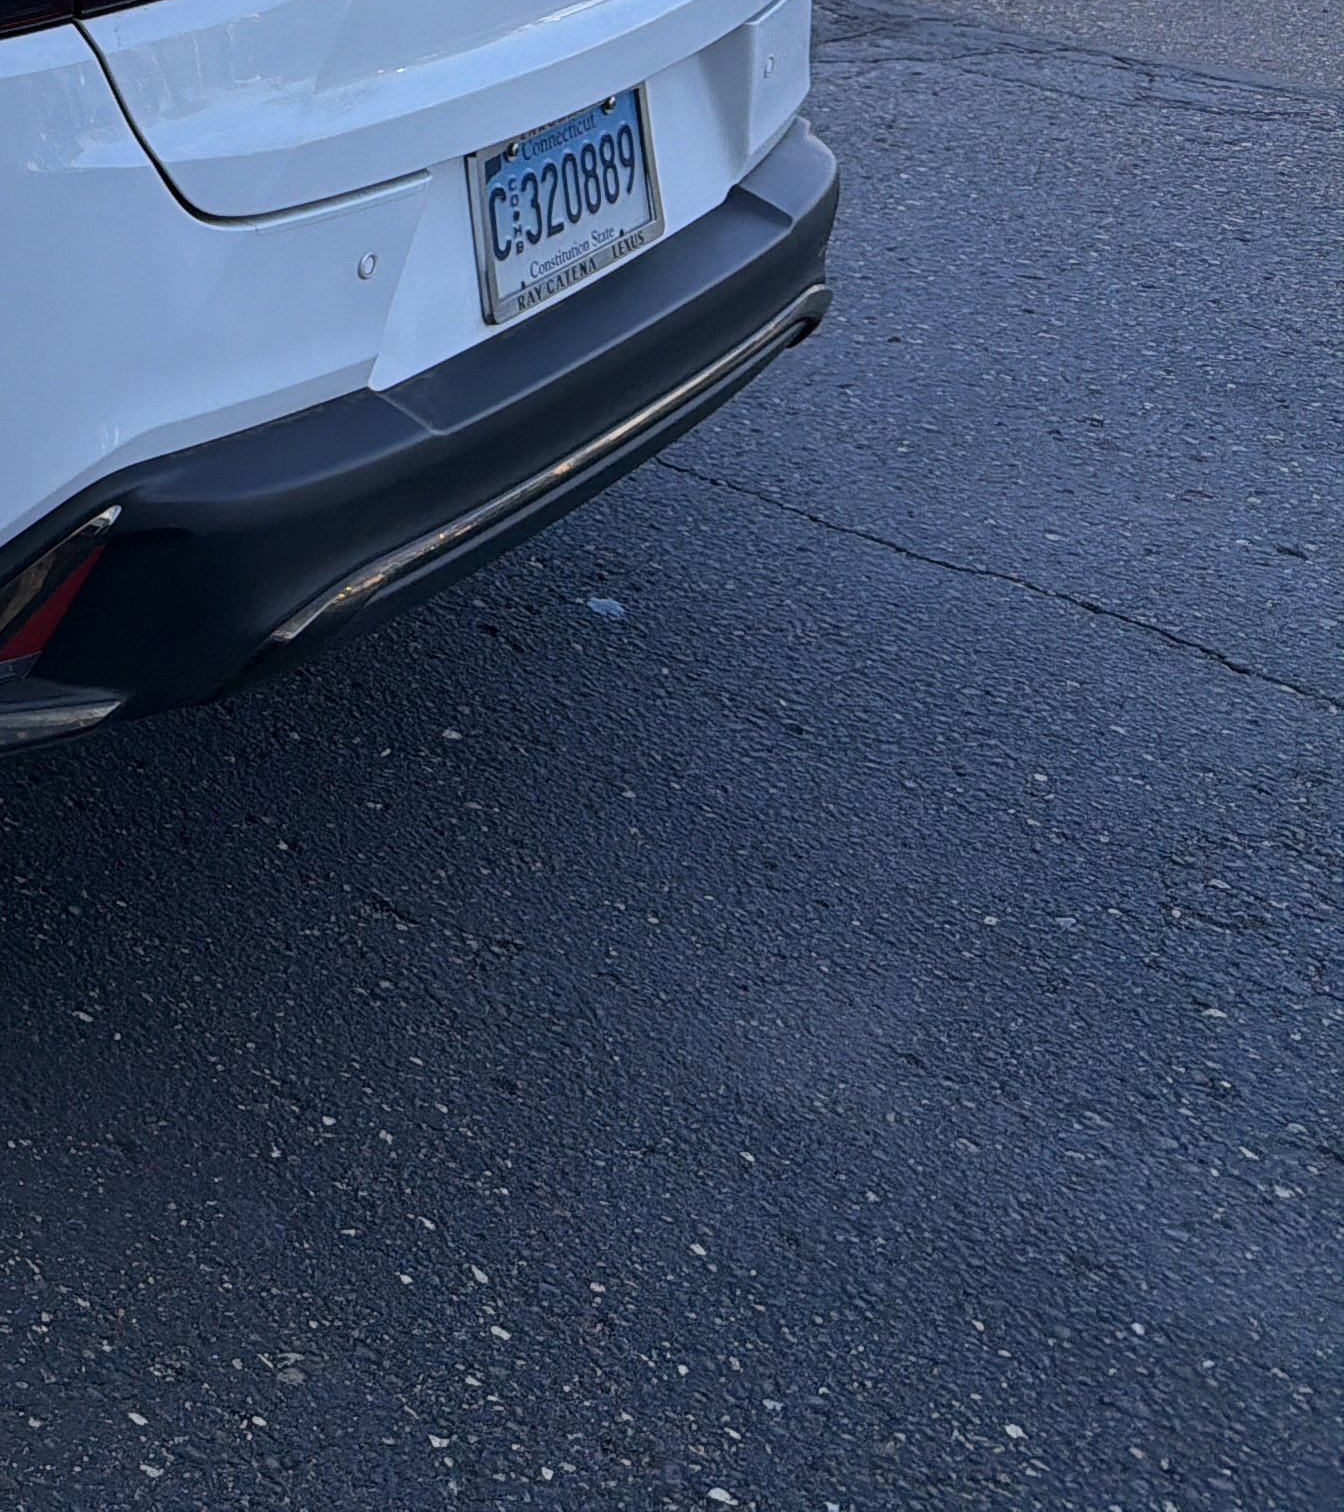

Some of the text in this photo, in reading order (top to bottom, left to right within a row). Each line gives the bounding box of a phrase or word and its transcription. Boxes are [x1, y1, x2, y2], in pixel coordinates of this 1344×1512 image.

[521, 114, 597, 161] Connecticut
[517, 233, 645, 313] RAY CATENA LEXUS
[529, 226, 616, 279] Constitution State
